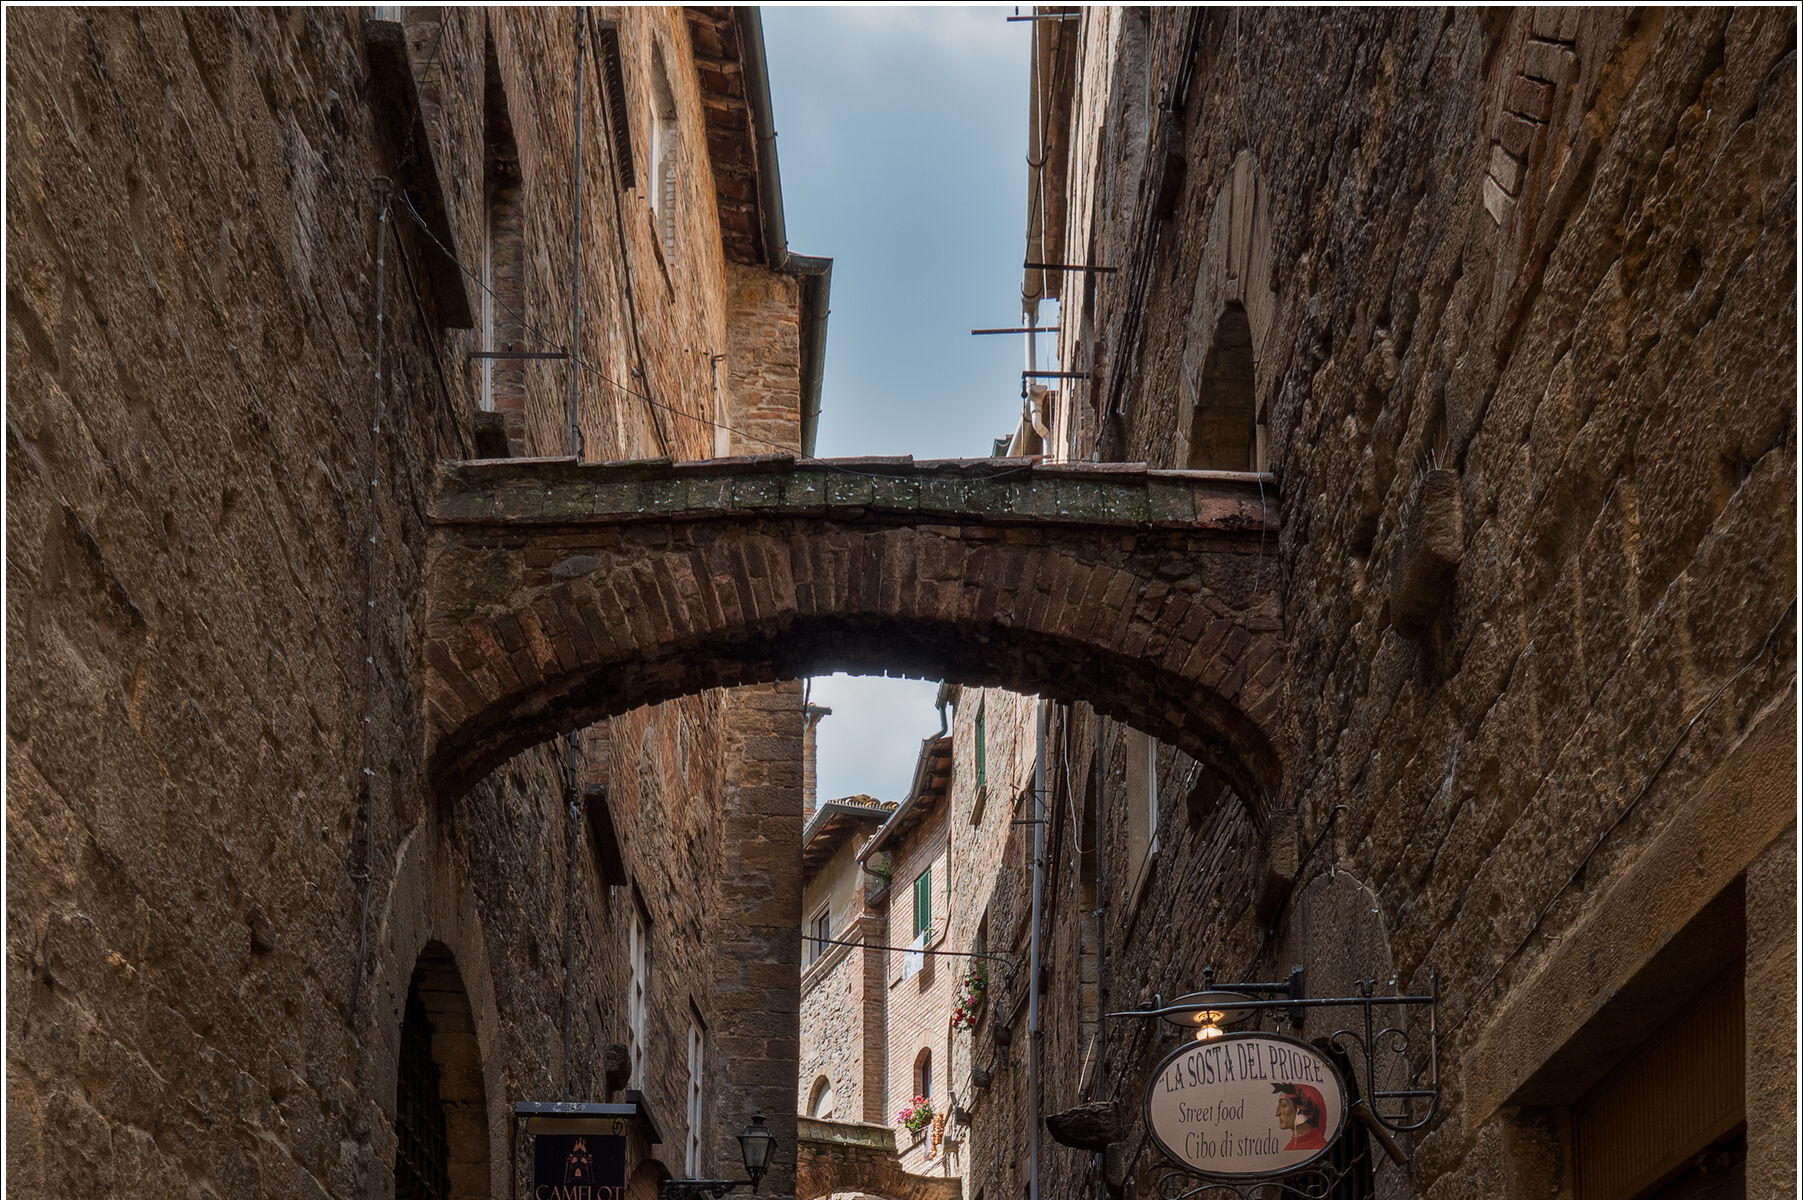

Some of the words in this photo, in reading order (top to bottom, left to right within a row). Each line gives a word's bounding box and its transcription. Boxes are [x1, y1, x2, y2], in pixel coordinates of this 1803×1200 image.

[1188, 1044, 1235, 1087] SOSTA
[1237, 1043, 1267, 1080] DEL
[1178, 1102, 1214, 1124] Street
[1214, 1099, 1244, 1127] food
[1185, 1131, 1216, 1159] Cibo
[1219, 1130, 1233, 1157] di
[1237, 1129, 1280, 1157] strada
